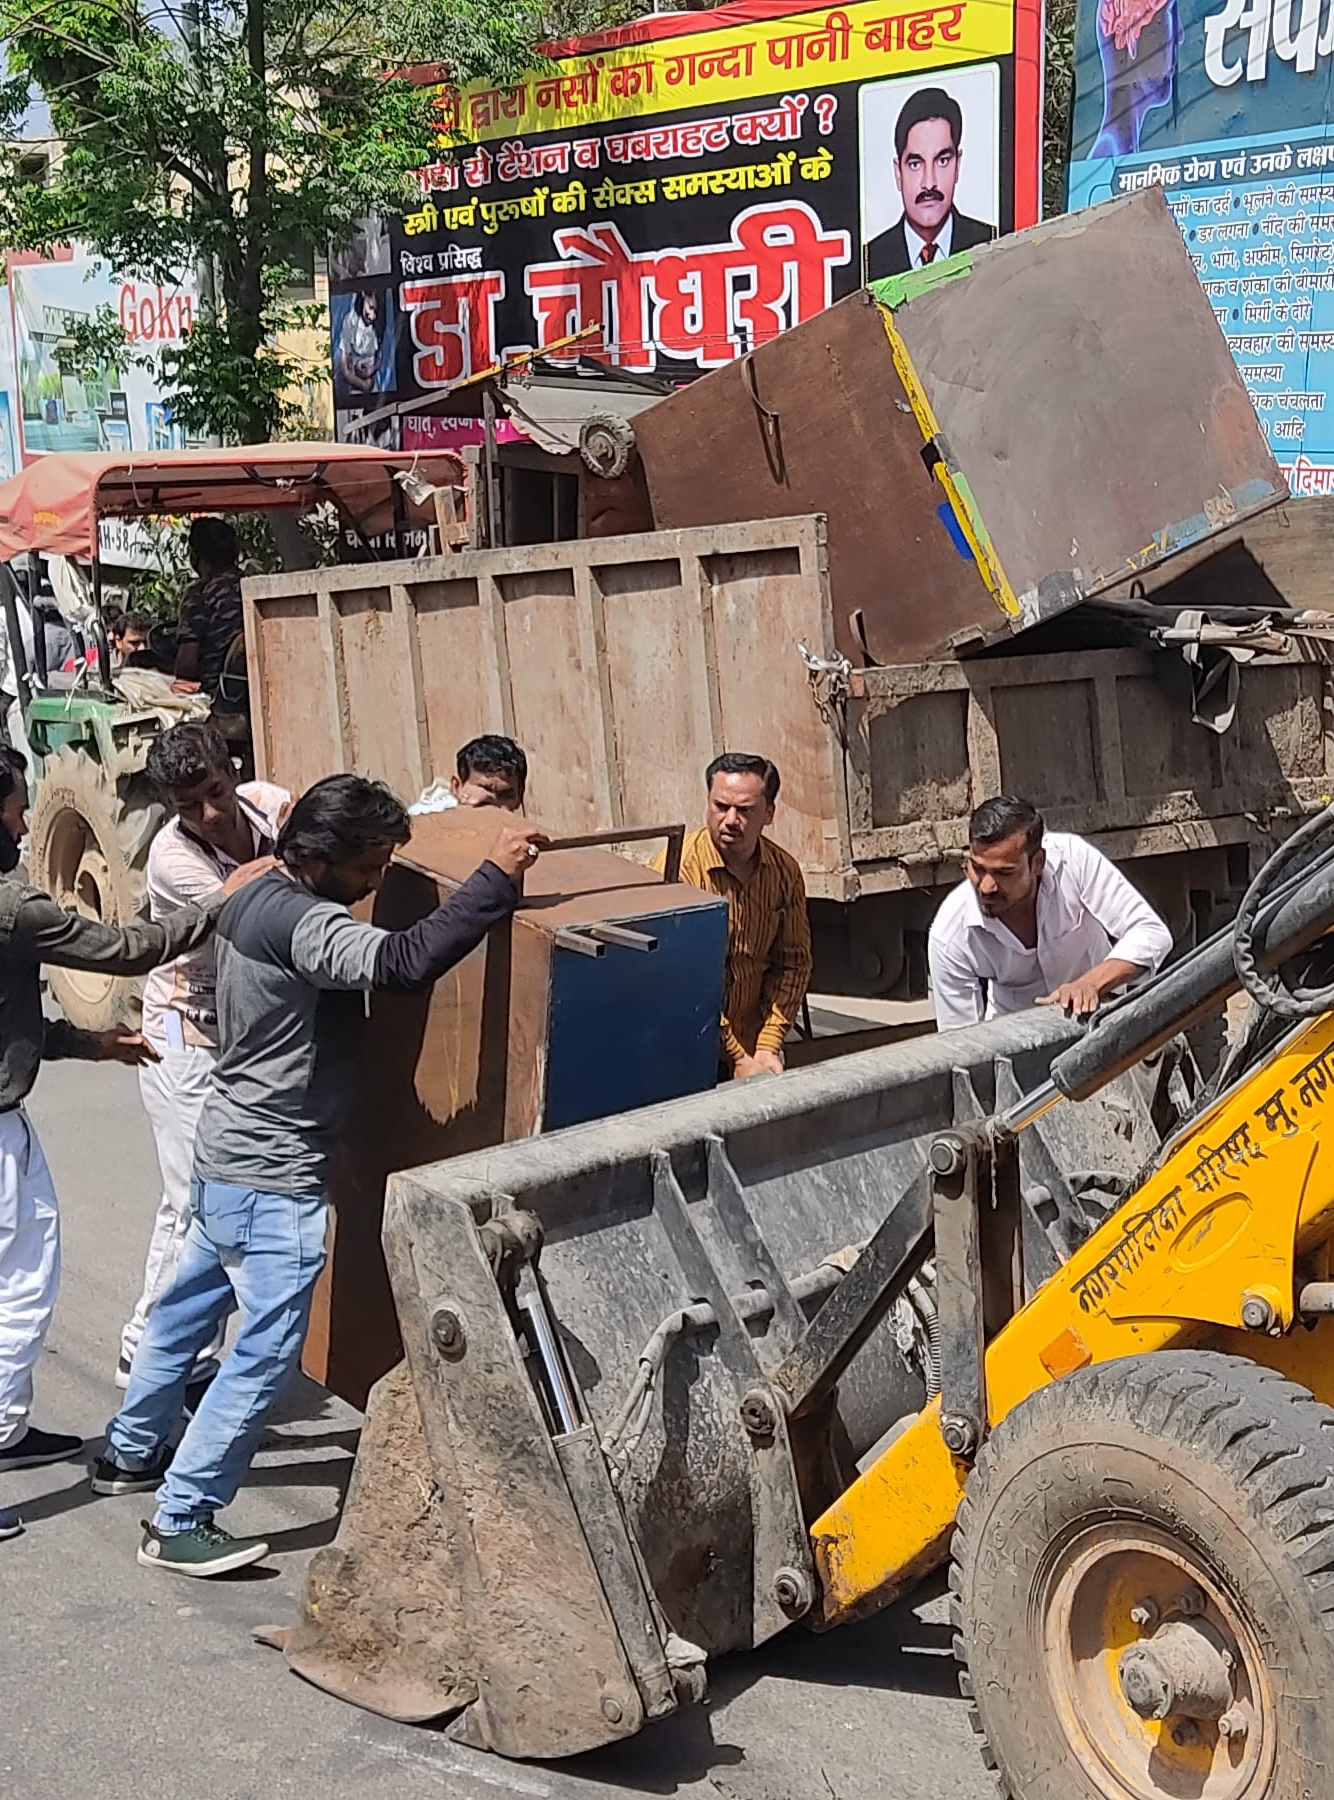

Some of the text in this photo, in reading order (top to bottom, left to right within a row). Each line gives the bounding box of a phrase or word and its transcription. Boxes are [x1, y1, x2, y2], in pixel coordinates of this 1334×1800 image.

[535, 57, 604, 109] नसों
[608, 60, 654, 98] का
[664, 42, 757, 86] गन्दा
[767, 11, 853, 70] पानी
[863, 3, 967, 51] बाहर
[465, 148, 490, 187] से
[499, 142, 568, 180] टेंशन
[575, 139, 598, 168] व
[605, 119, 728, 163] घबराहट
[733, 95, 809, 144] क्यों
[815, 95, 837, 133] ?
[1119, 164, 1181, 191] मानसिक
[1184, 157, 1216, 180] रोग
[1222, 151, 1245, 179] एवं
[1250, 145, 1292, 175] उनके
[403, 203, 438, 236] स्त्री
[443, 196, 478, 230] एवं
[552, 180, 587, 213] की
[592, 176, 656, 209] सैक्स
[662, 151, 796, 200] समस्याओं
[799, 146, 833, 180] के
[1193, 199, 1209, 214] का
[1214, 191, 1230, 213] दर्द
[1244, 187, 1274, 215] भूलने
[1278, 182, 1296, 206] की
[1198, 226, 1215, 242] डर
[1218, 224, 1250, 239] लगना
[1288, 212, 1305, 232] की
[400, 244, 483, 276] विश्व प्रसिद्ध
[1212, 250, 1240, 270] भांग,
[1244, 244, 1286, 267] अफीम,
[526, 198, 852, 375] चौधरी
[1229, 280, 1237, 293] व
[1243, 275, 1271, 294] शंका
[1275, 271, 1293, 291] की
[1245, 300, 1272, 322] मिर्गी
[1276, 300, 1288, 319] के
[1228, 336, 1272, 354] व्यवहार
[1277, 329, 1295, 350] की
[1244, 366, 1284, 381] समस्या
[1278, 390, 1324, 409] चंचलता
[1274, 418, 1304, 440] आदि
